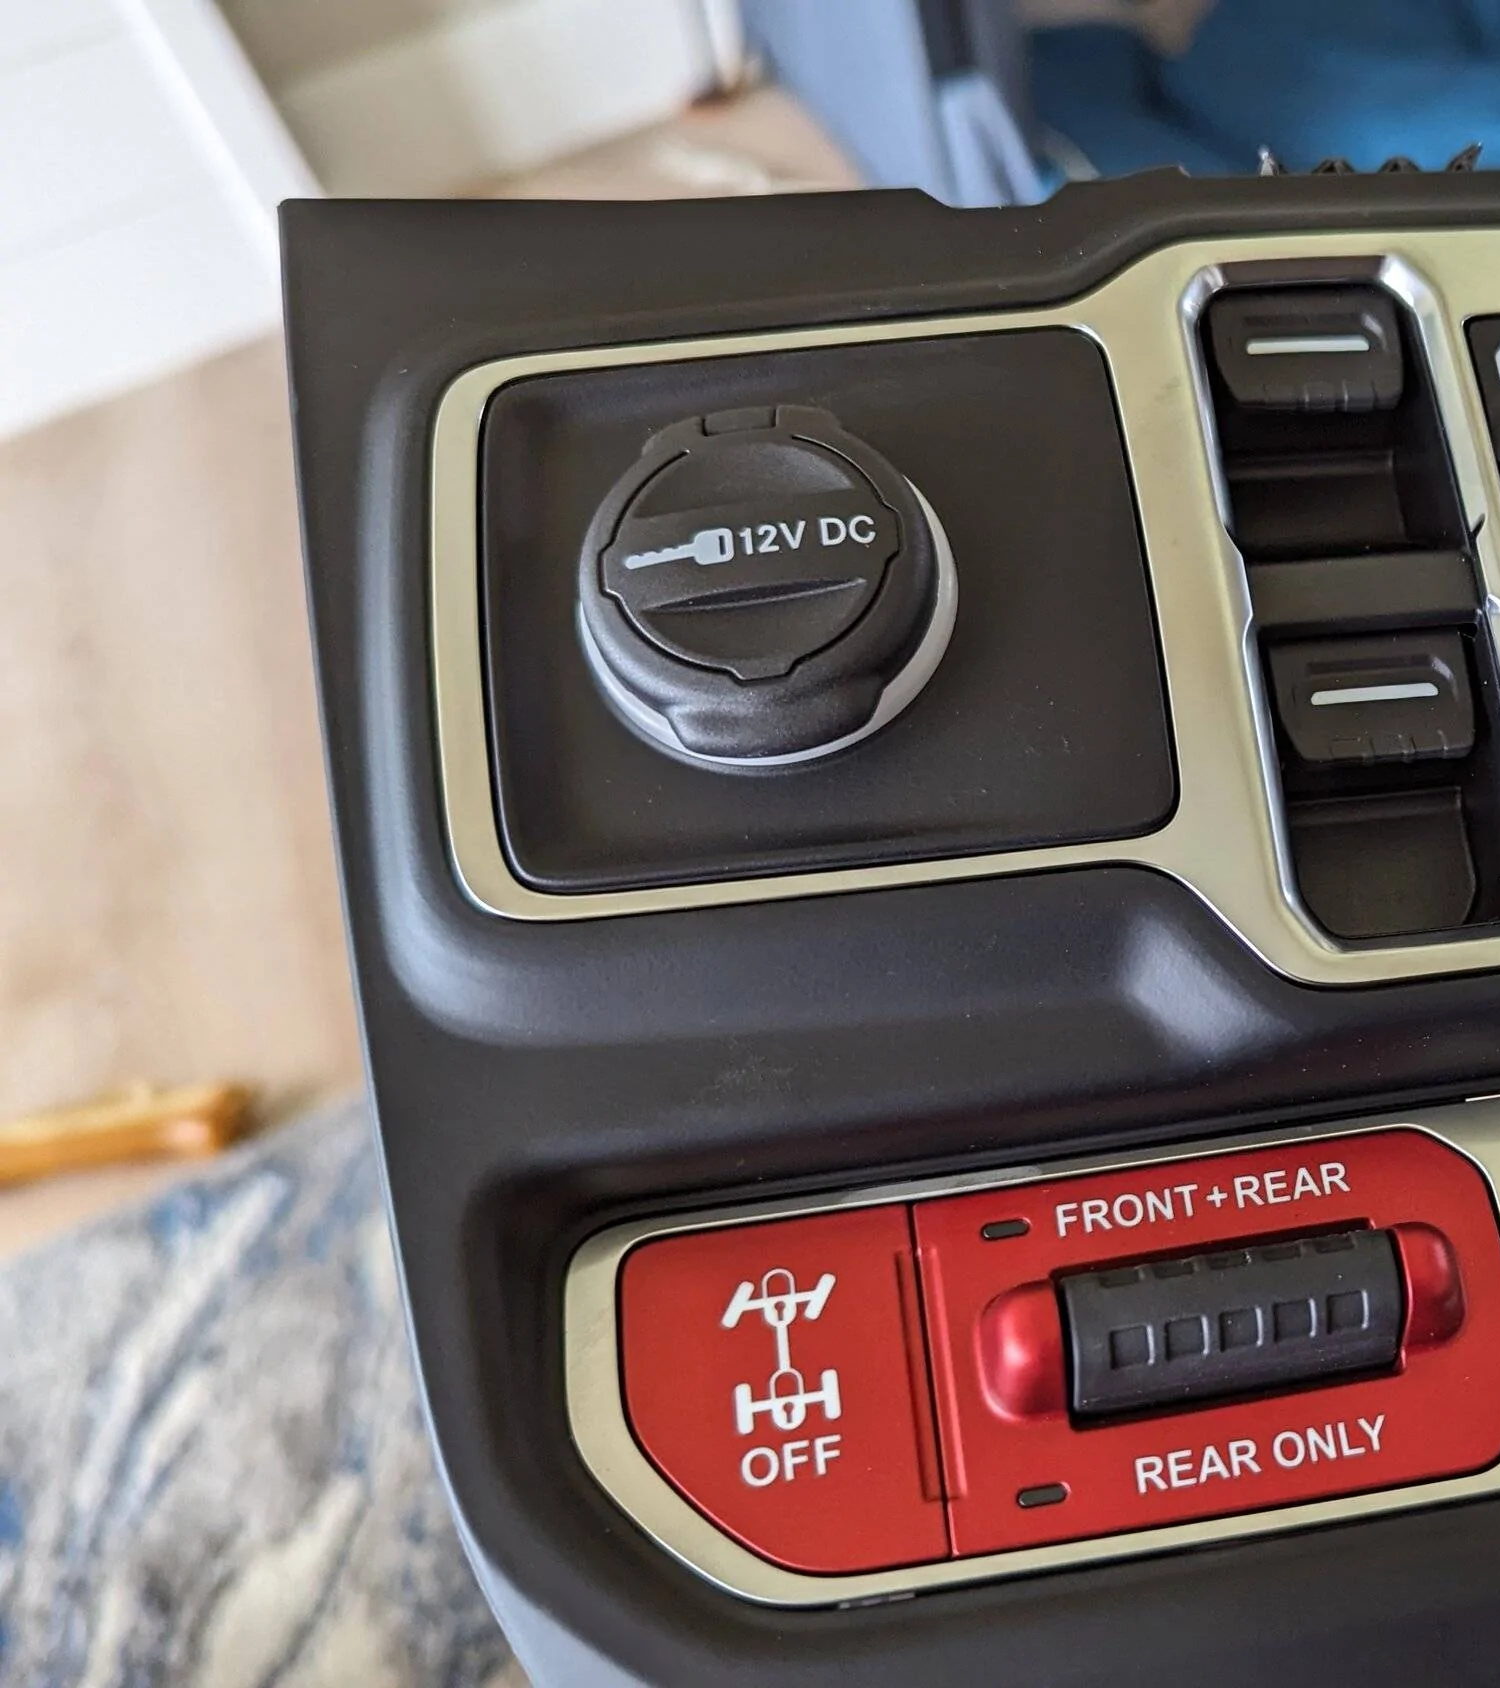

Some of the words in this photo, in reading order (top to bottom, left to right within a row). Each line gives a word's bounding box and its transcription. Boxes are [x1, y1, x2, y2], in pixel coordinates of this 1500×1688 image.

[738, 520, 806, 556] 12V
[819, 515, 877, 547] DC
[740, 1434, 842, 1489] OFF
[1134, 1438, 1263, 1495] REAR
[1271, 1414, 1386, 1469] ONLY
